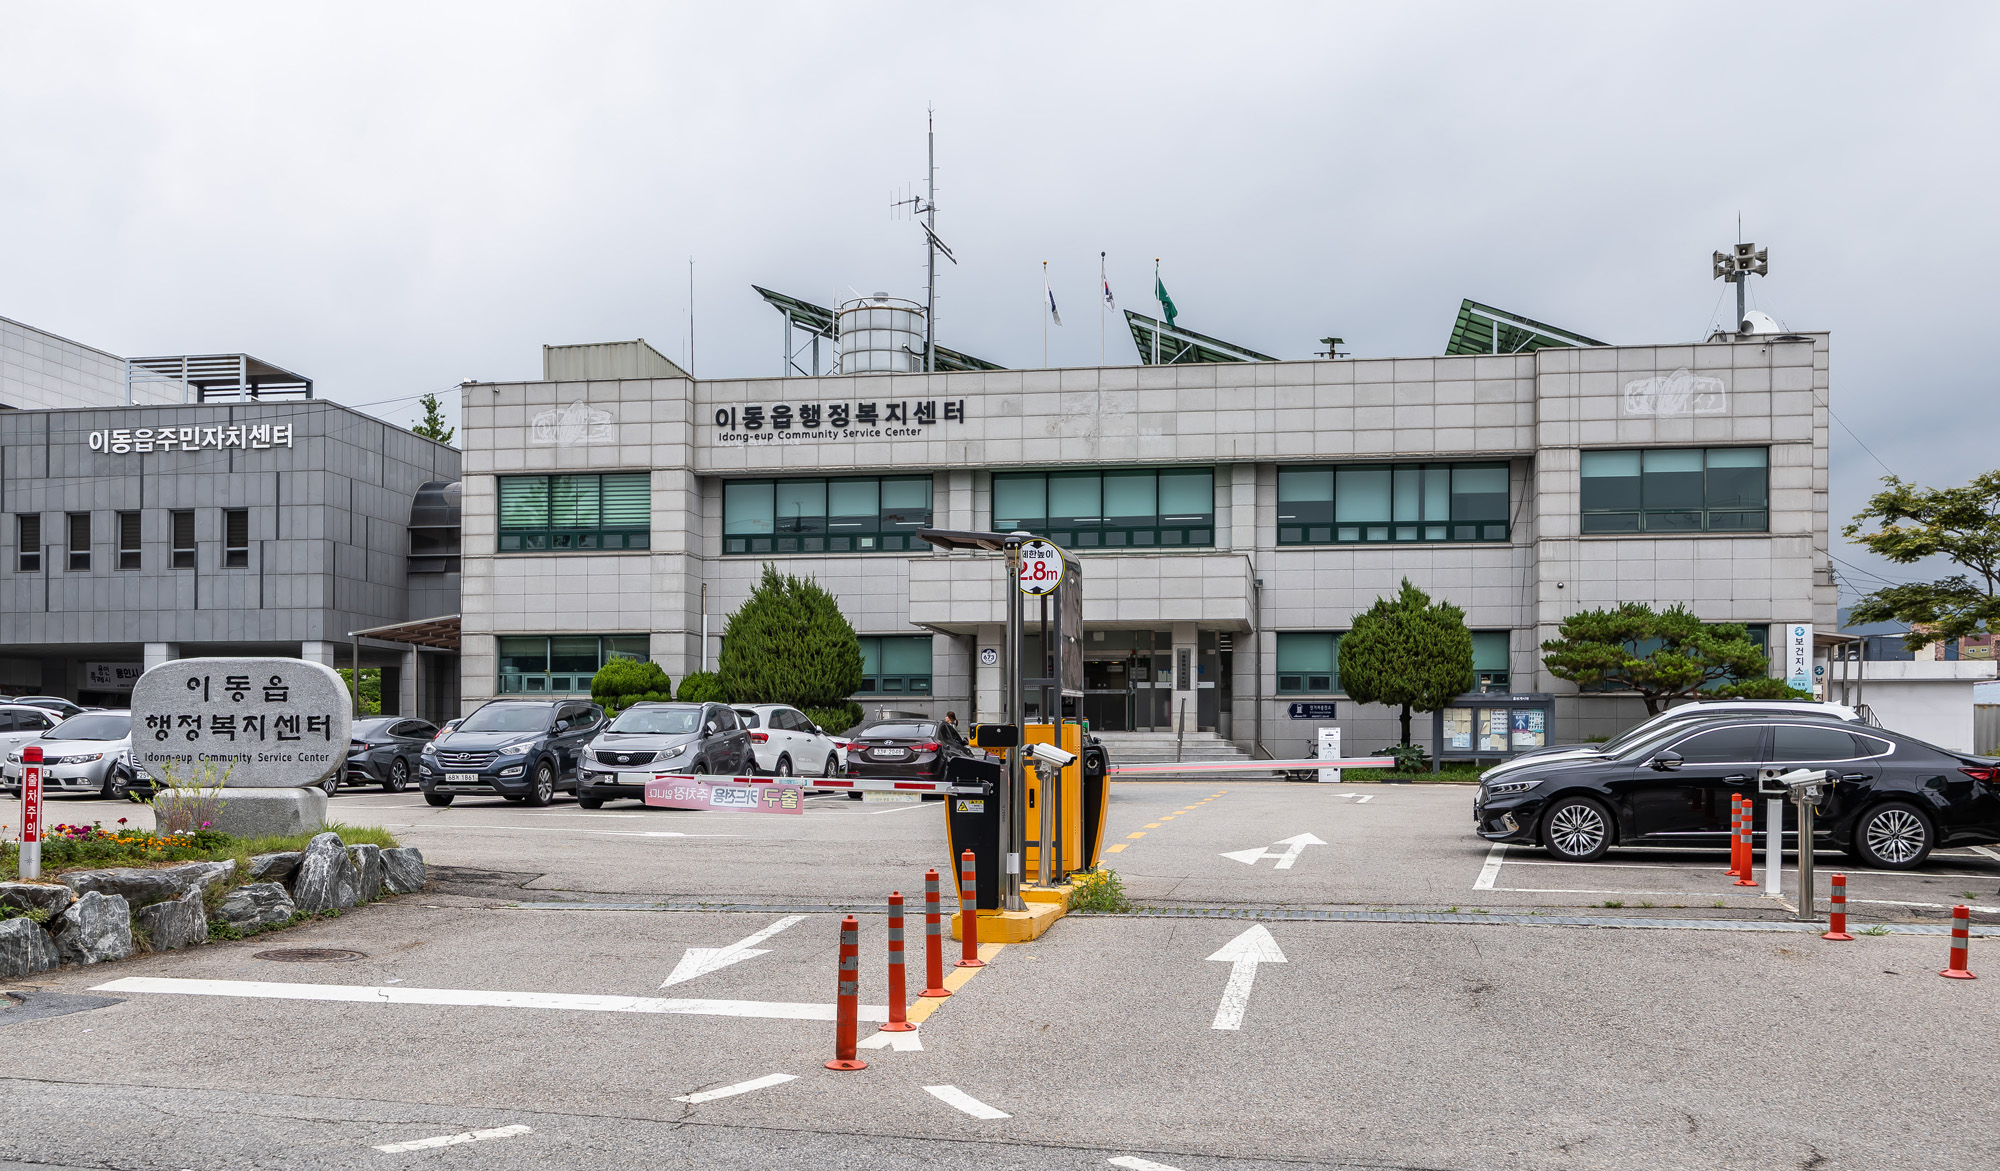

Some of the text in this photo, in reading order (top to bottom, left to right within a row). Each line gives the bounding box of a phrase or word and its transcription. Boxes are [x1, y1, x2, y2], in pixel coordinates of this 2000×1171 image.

[715, 399, 964, 431] 이동읍행정복지센터
[89, 423, 293, 454] 이동읍주민자치센터
[719, 427, 922, 443] Idong-eup Community Service Center
[1020, 561, 1058, 581] 2.8m
[1795, 638, 1804, 675] 보건지소
[116, 669, 138, 678] 용인시
[186, 675, 289, 702] 이동읍
[145, 714, 331, 741] 행정복지센터
[144, 752, 330, 764] Idong-eup Community Service Center
[26, 773, 37, 836] 출차주의
